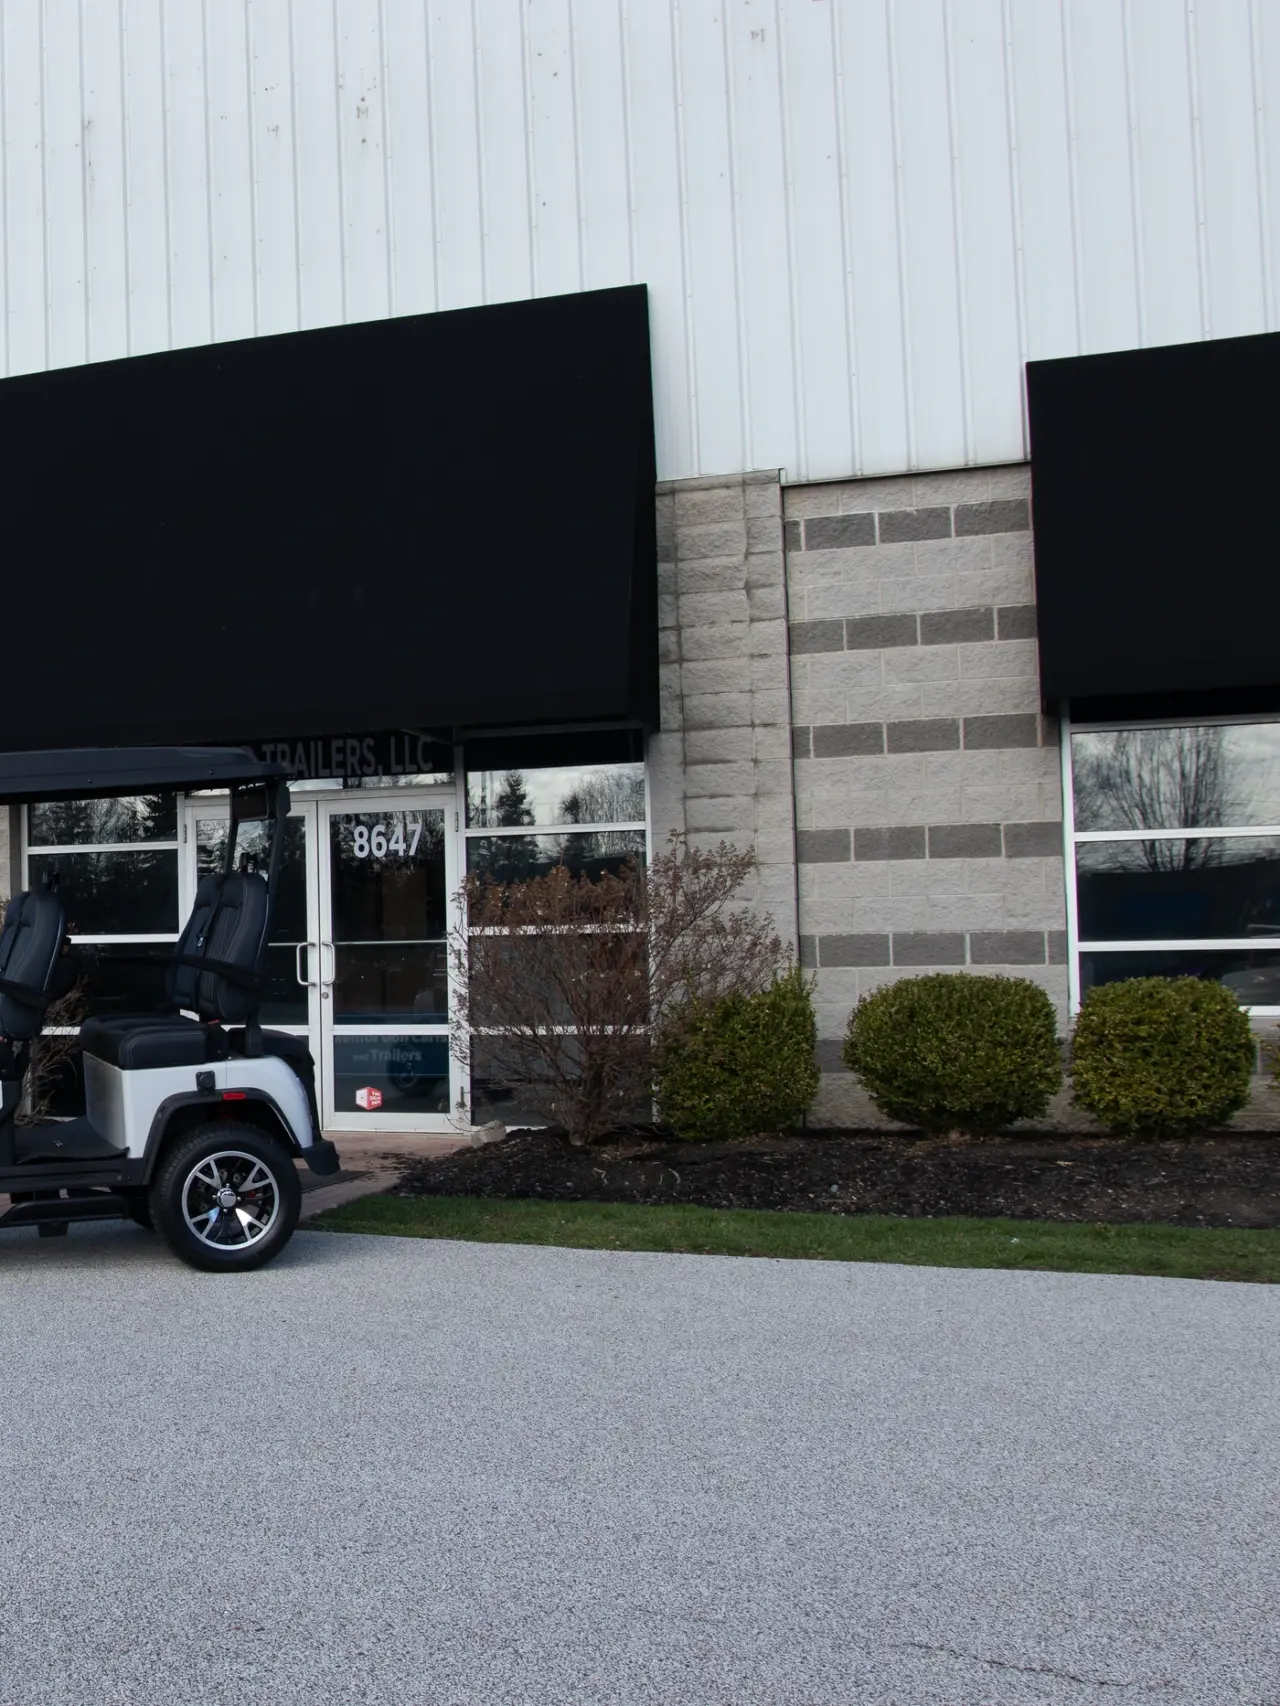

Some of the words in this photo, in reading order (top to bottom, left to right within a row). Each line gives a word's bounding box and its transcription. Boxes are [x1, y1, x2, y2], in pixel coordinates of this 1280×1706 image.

[261, 738, 383, 777] TRAILERS,
[390, 735, 433, 773] LLC
[353, 824, 422, 858] 8647
[370, 1048, 422, 1062] Trailers
